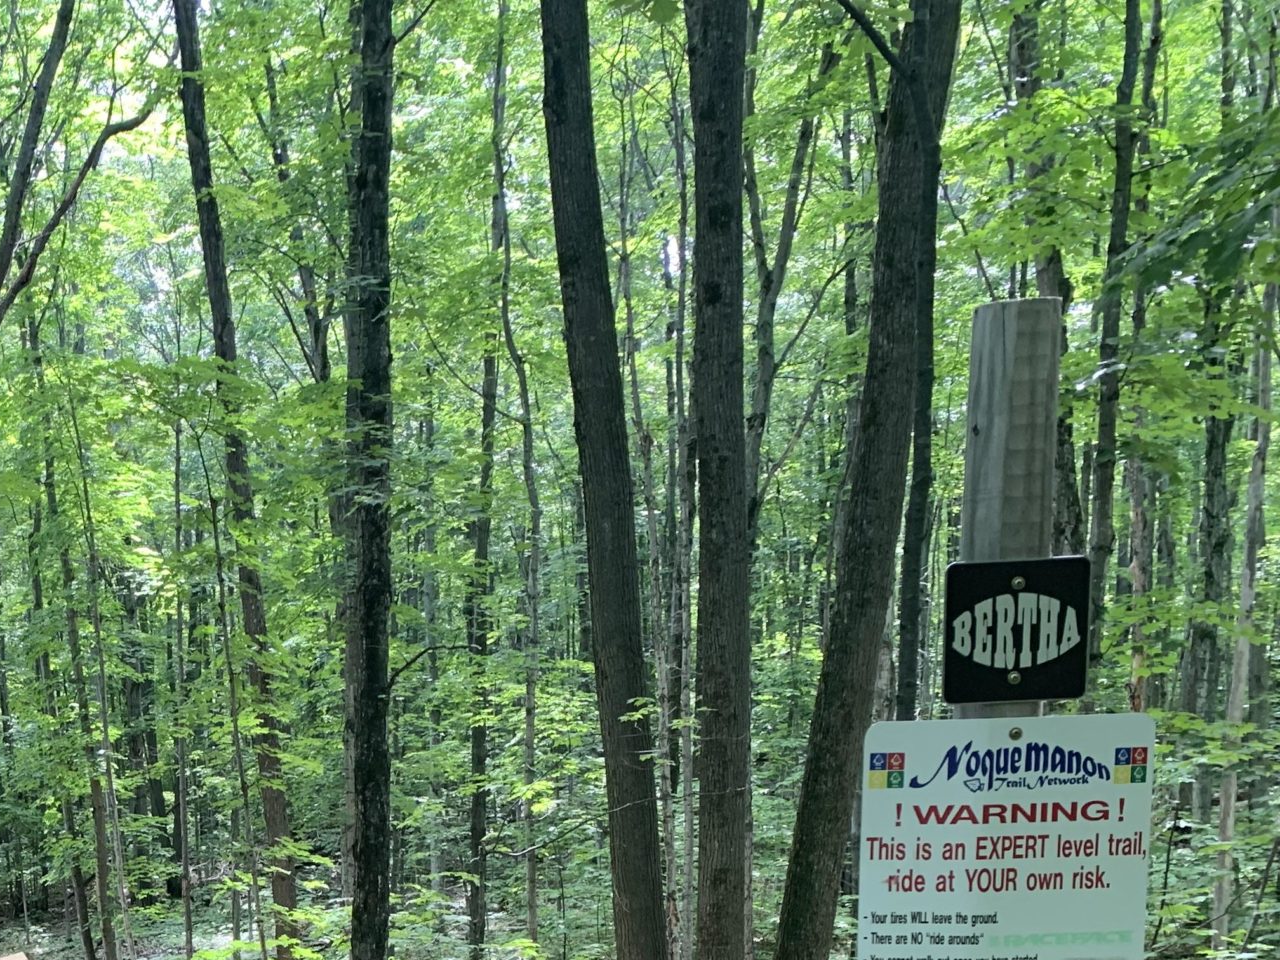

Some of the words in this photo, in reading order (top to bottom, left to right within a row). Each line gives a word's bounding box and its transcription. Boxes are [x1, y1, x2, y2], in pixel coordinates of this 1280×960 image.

[952, 592, 1081, 670] BERTHA
[995, 778, 1027, 791] Trail
[1028, 774, 1089, 790] Network
[866, 837, 906, 860] This
[916, 837, 932, 860] is
[942, 843, 965, 860] an
[976, 835, 1049, 859] EXPERT
[1057, 833, 1099, 858] level
[1108, 832, 1146, 859] trail,
[887, 869, 925, 892] ride
[936, 870, 955, 892] at
[965, 868, 1017, 892] YOUR
[1027, 871, 1063, 891] own
[1072, 865, 1110, 889] risk.
[871, 911, 887, 924] Your
[891, 912, 907, 924] tires
[911, 912, 929, 924] WILL
[932, 912, 952, 924] leave
[956, 913, 968, 924] the
[972, 912, 998, 927] ground.
[871, 932, 892, 944] There
[895, 936, 907, 944] are
[911, 933, 923, 944] NO
